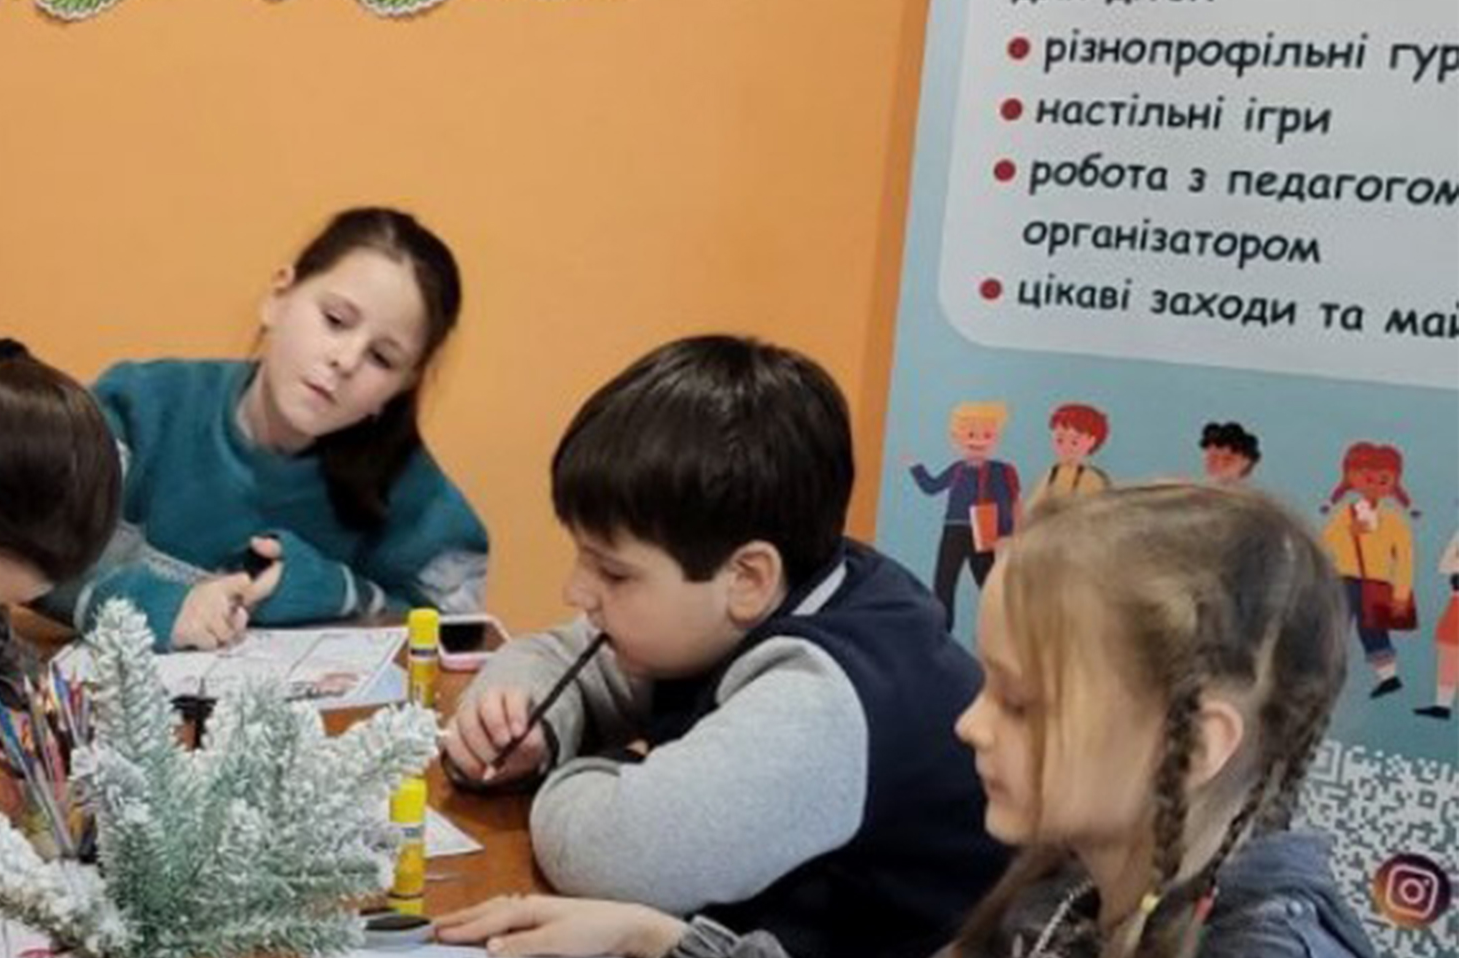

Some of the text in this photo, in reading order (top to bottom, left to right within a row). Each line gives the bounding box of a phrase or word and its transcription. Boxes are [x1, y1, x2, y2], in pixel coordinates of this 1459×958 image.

[1043, 28, 1369, 78] різнопрофільні
[1035, 92, 1332, 143] настільні ігри
[1028, 151, 1169, 196] робота
[1188, 167, 1208, 193] з
[1022, 217, 1321, 270] організатором
[1017, 272, 1134, 312] цікаві
[1150, 288, 1297, 328] заходи
[1318, 302, 1364, 332] та
